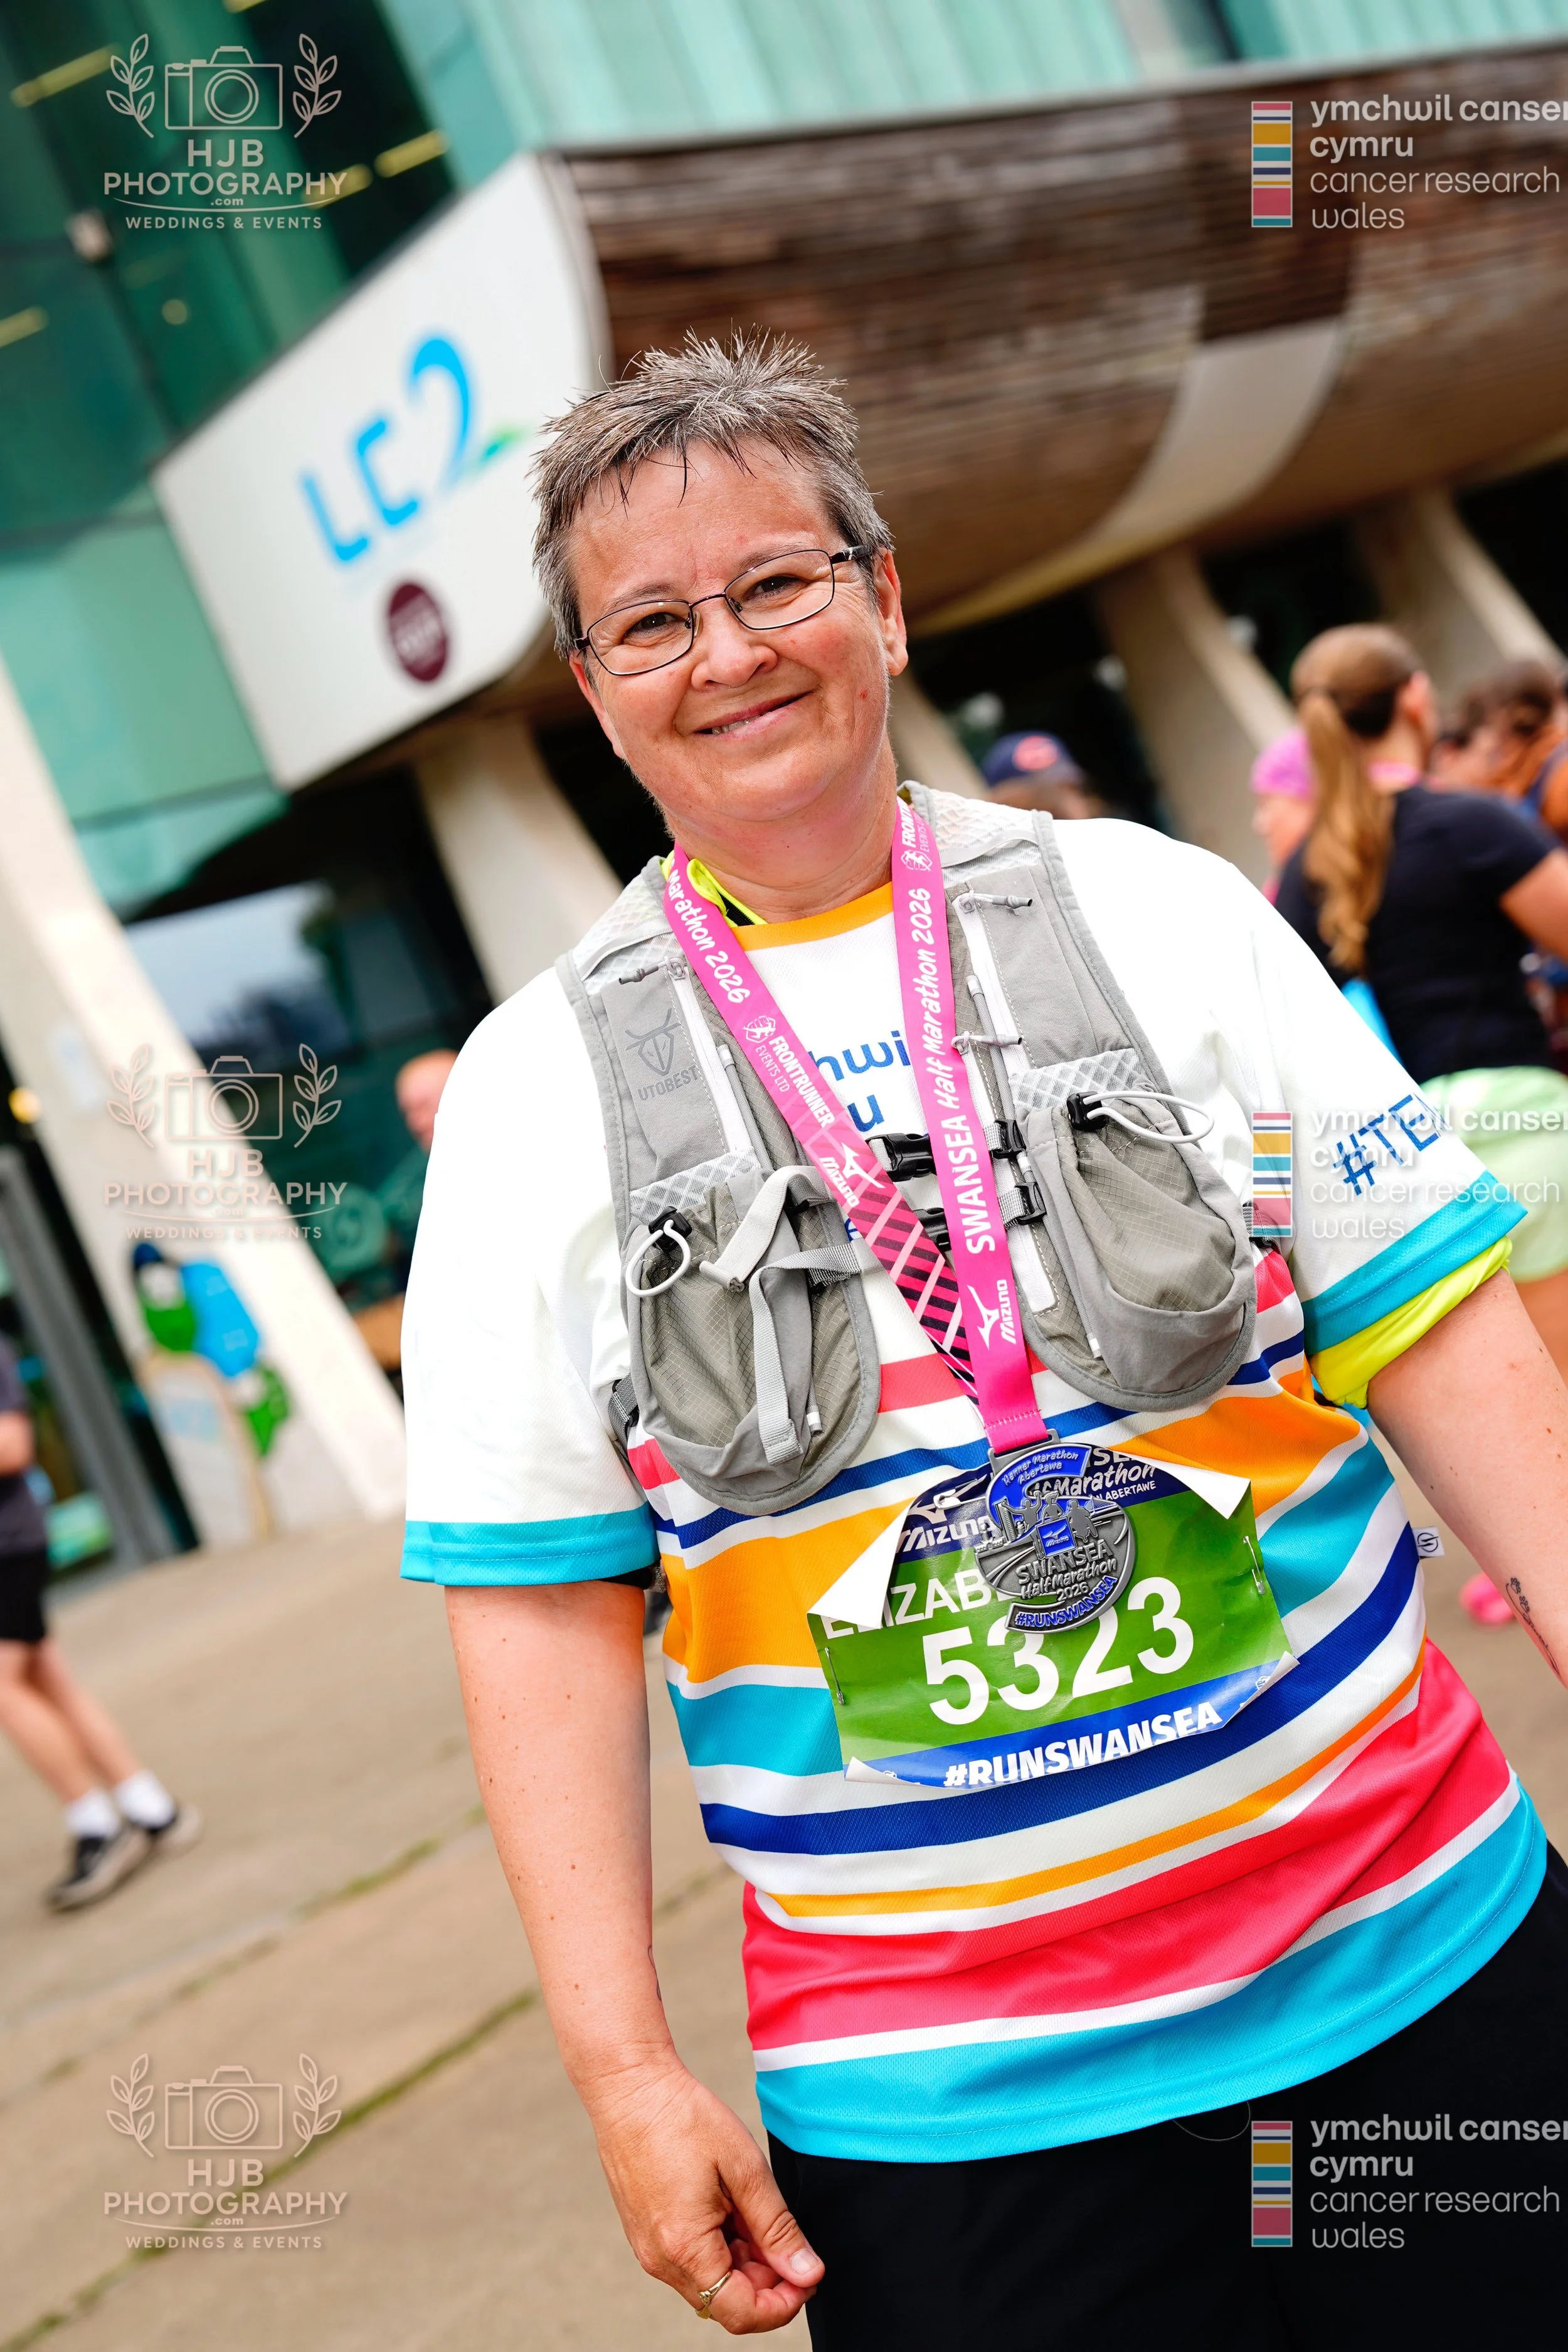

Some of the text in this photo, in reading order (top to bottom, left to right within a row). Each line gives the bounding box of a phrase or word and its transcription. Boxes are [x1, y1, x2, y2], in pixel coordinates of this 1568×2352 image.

[704, 950, 751, 1004] 2026
[637, 1066, 698, 1101] UTOBEST
[755, 1044, 790, 1093] EVENTS LTD
[768, 1035, 835, 1128] FRONTRUNNER
[908, 887, 996, 1254] SWANSEA Half Marathon 2026
[1002, 1449, 1079, 1485] Hanner Marathon
[1018, 1461, 1062, 1485] Abertawe
[1105, 1480, 1157, 1501] ABERTAWE
[1015, 1539, 1113, 1584] SWANSEA
[1014, 1574, 1118, 1628] #RUNSWANSEA
[1055, 1582, 1089, 1601] 2026
[922, 1577, 1195, 1726] 5323
[943, 1701, 1223, 1787] #RUNSWANSEA
